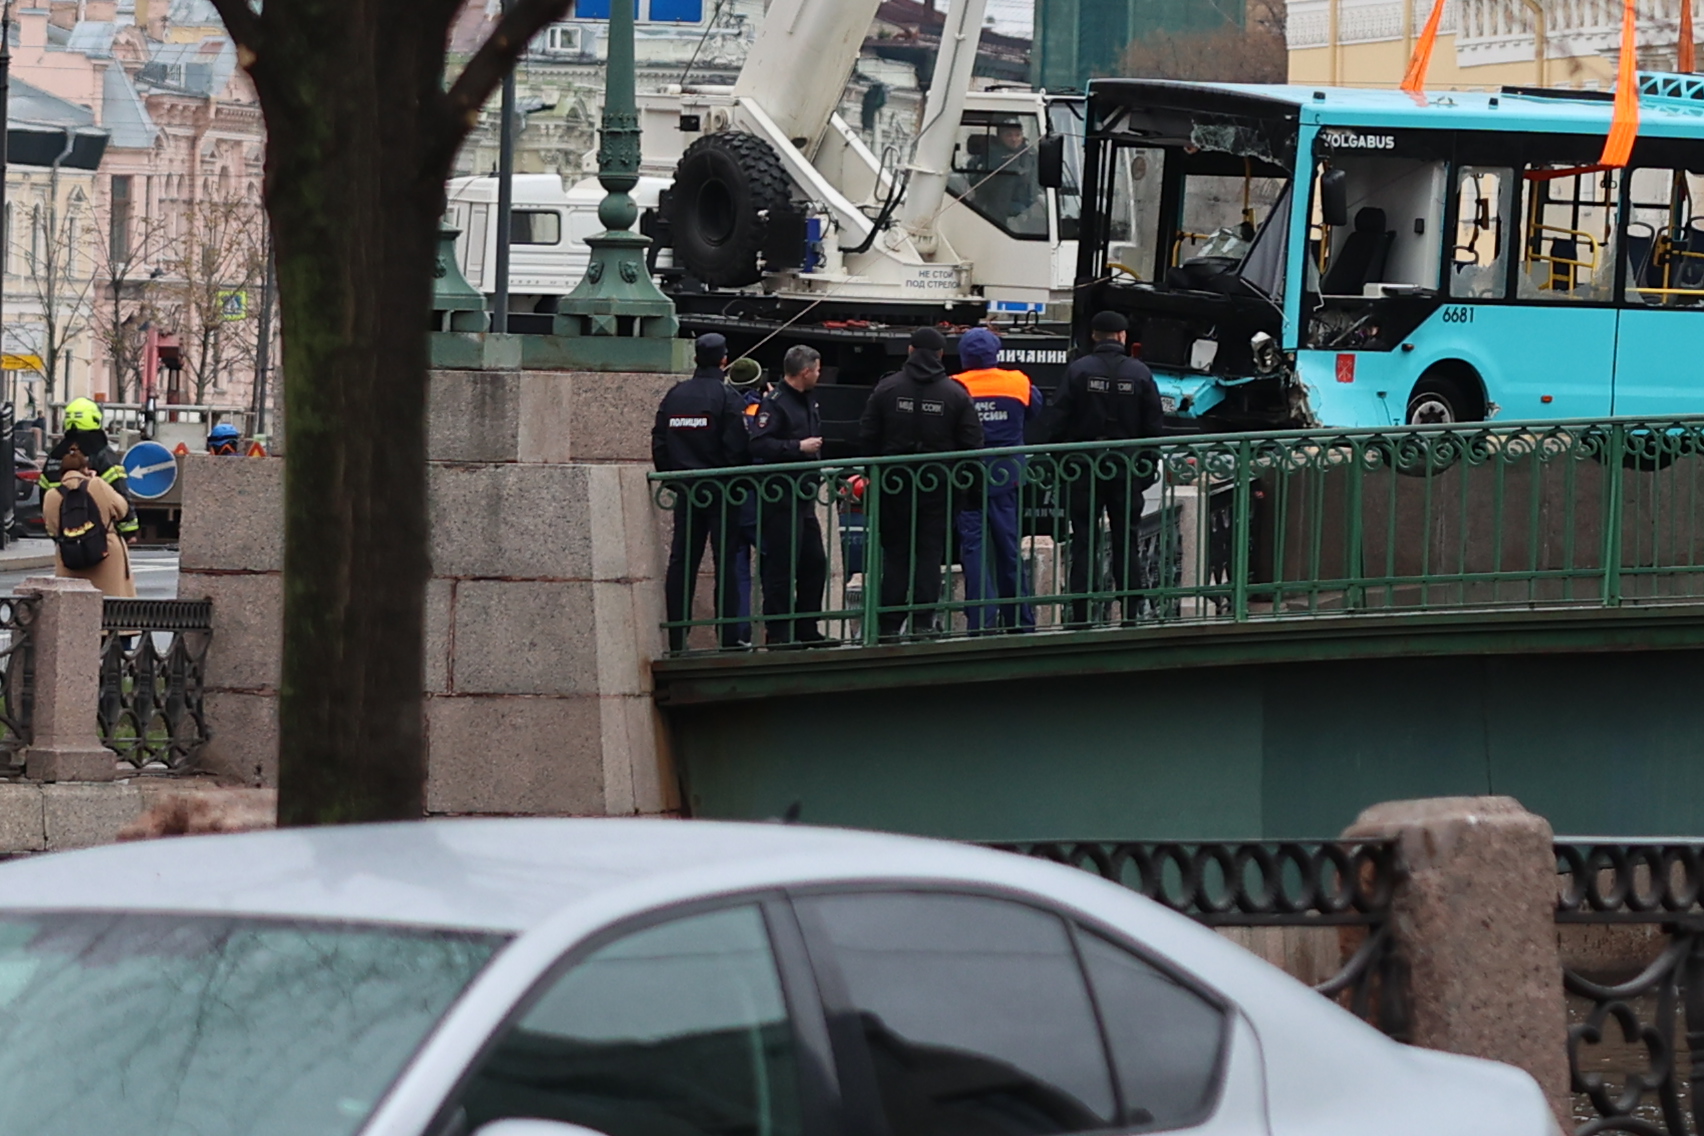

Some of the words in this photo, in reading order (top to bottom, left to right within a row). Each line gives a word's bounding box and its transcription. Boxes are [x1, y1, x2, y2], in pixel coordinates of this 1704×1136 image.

[918, 270, 931, 278] НЕ
[905, 279, 926, 289] ПОД
[927, 280, 962, 289] СТРЕЛО
[1442, 306, 1474, 324] 6681
[996, 349, 1067, 364] ЛИЧАНИН
[669, 417, 708, 428] ПОЛИЦИЯ
